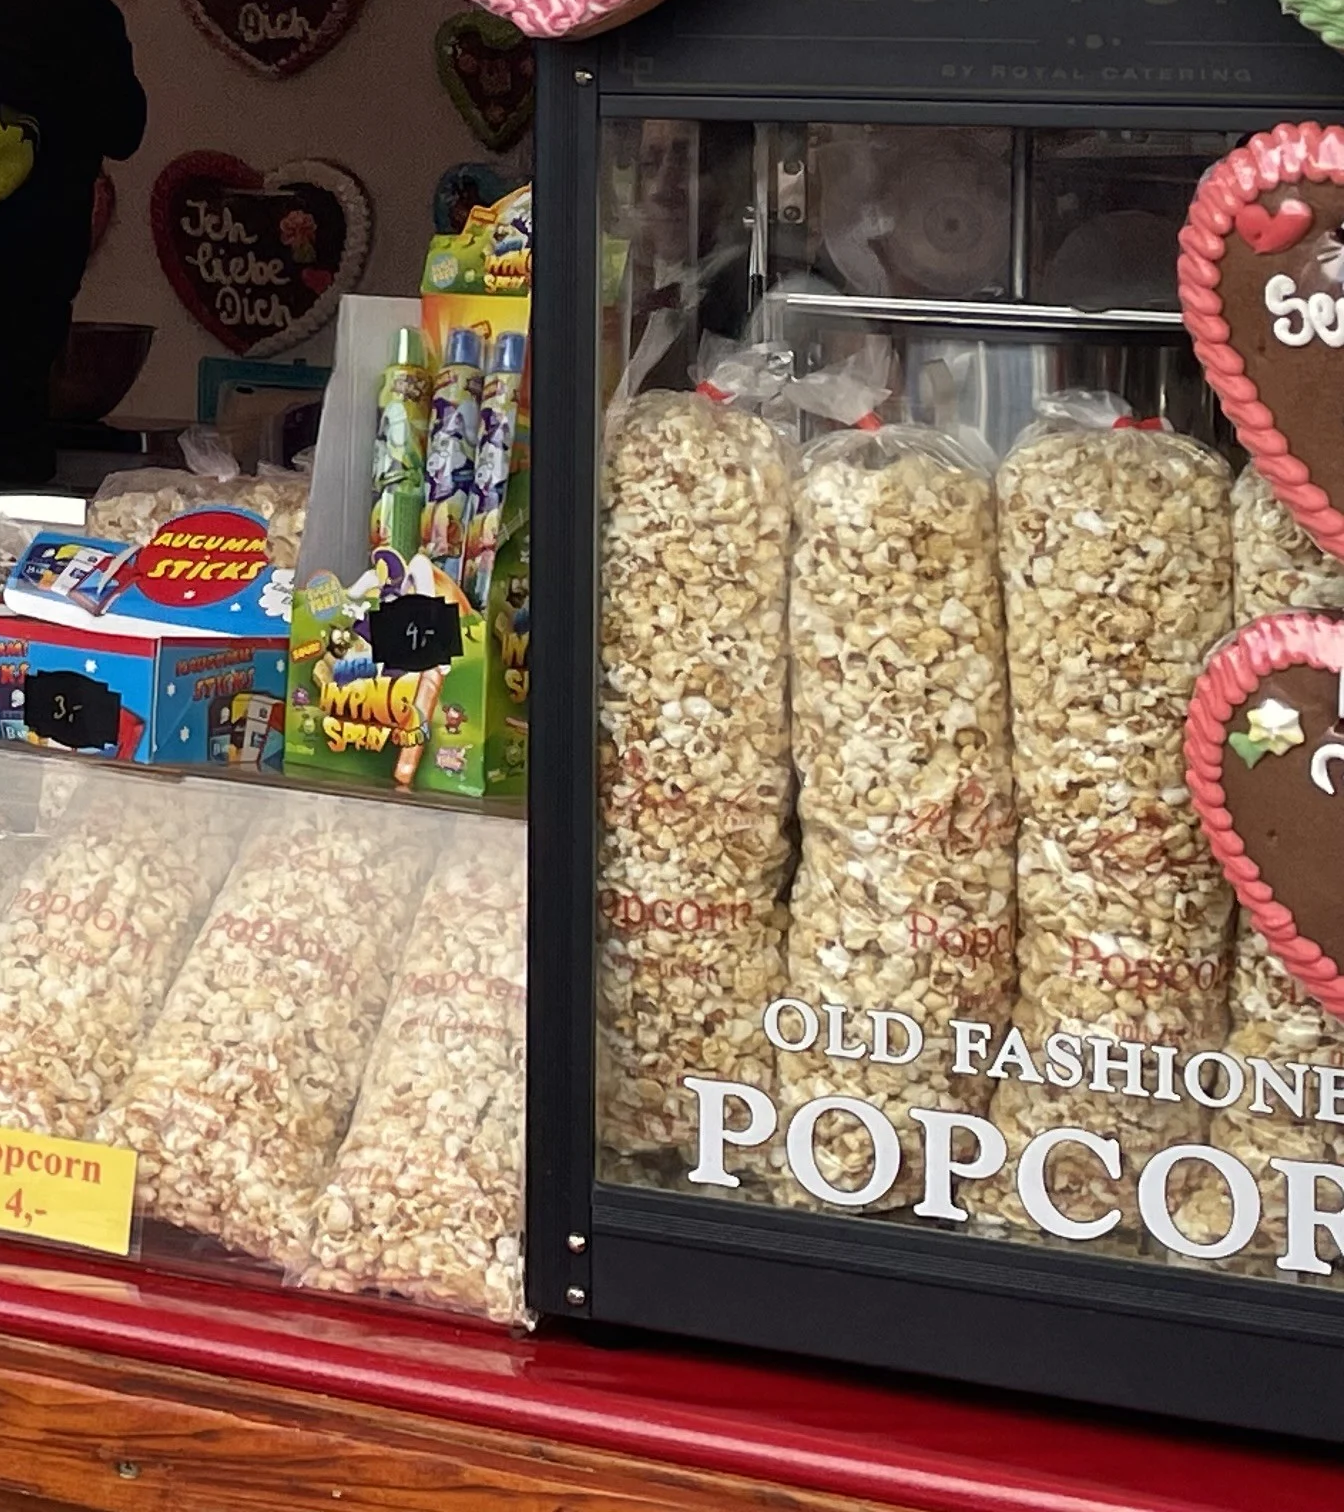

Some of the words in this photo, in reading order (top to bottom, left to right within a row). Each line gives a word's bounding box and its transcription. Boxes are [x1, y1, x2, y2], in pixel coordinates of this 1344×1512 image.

[240, 2, 310, 43] Dich
[990, 64, 1087, 82] ROYAL
[1101, 64, 1254, 84] CATERING
[181, 199, 258, 244] Ich
[216, 285, 294, 329] Dich
[322, 715, 392, 753] SPRAY
[762, 997, 924, 1065] OLD
[950, 1018, 1344, 1124] FASHIONE
[683, 1076, 1344, 1277] POPCOR
[4, 1187, 49, 1228] 4,-
